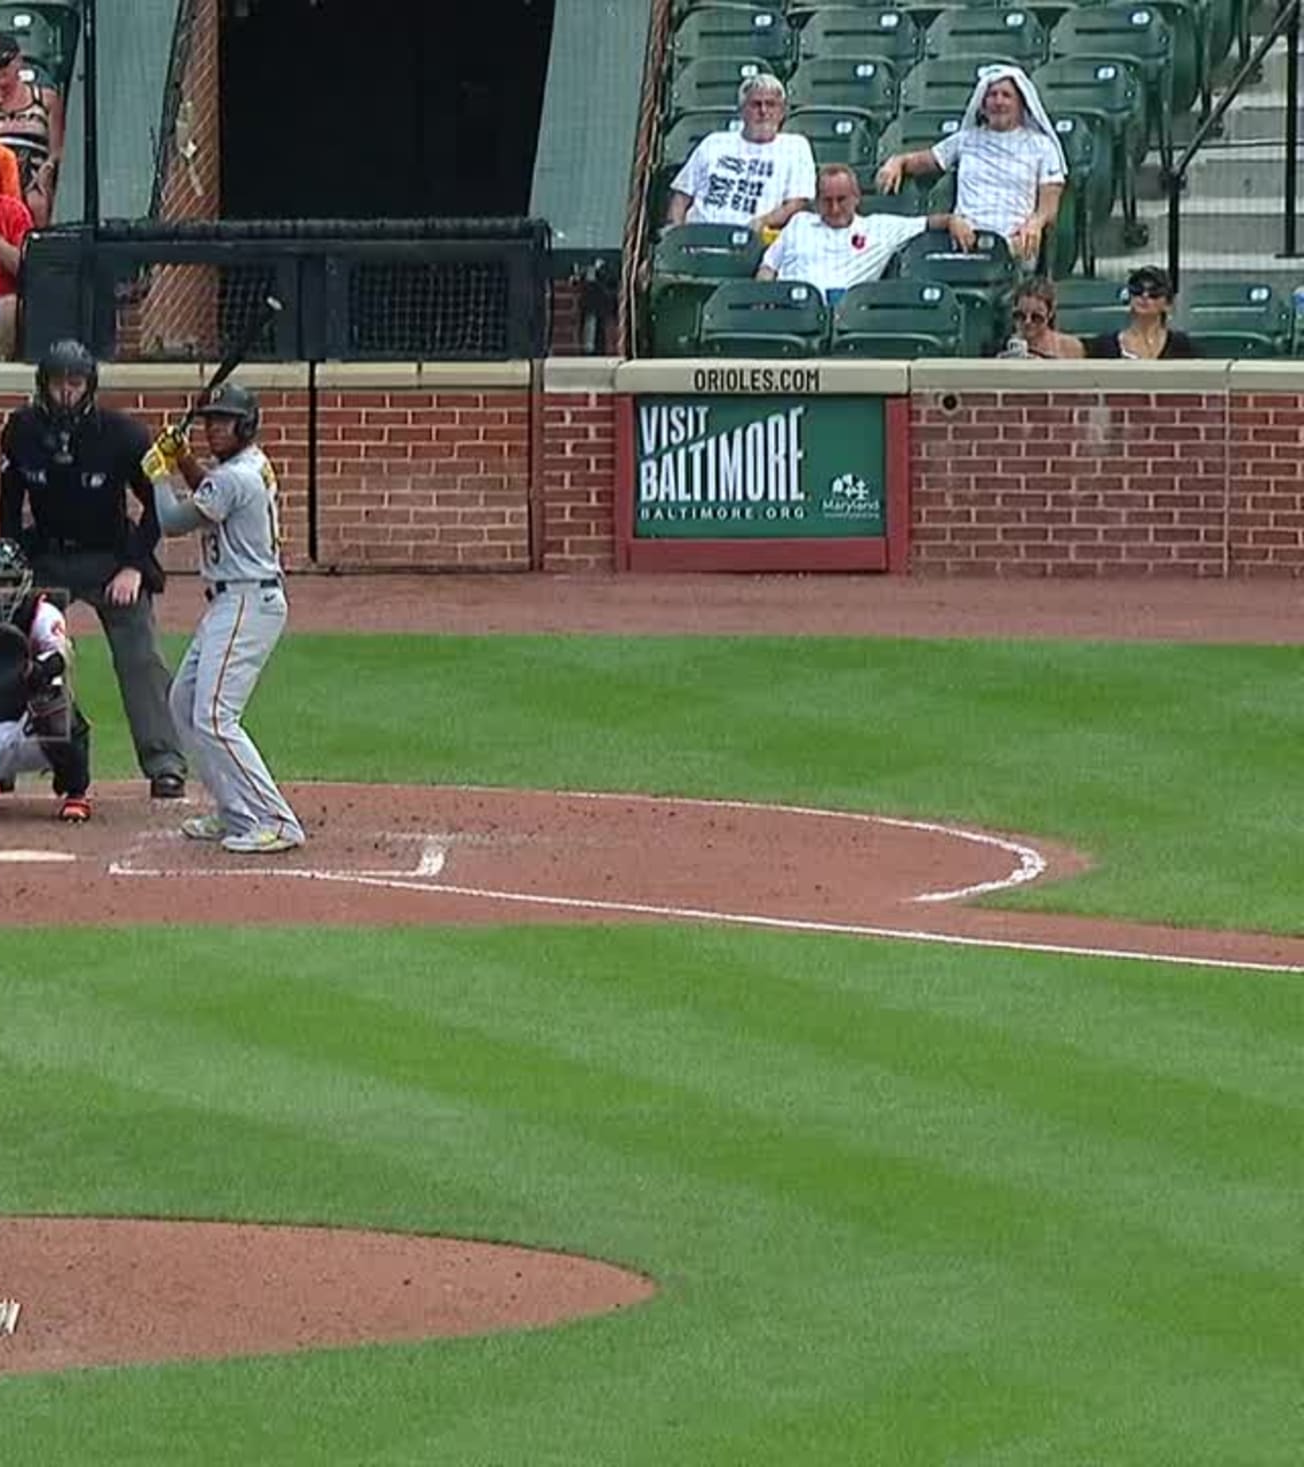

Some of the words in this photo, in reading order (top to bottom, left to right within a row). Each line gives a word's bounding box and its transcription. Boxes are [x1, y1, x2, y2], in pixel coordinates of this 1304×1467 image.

[695, 369, 820, 391] ORIOLES.COM
[640, 406, 708, 456] VISIT
[640, 406, 805, 502] BALTIMORE
[640, 506, 804, 521] BALTIMORE.ORG
[822, 500, 880, 516] Maryland
